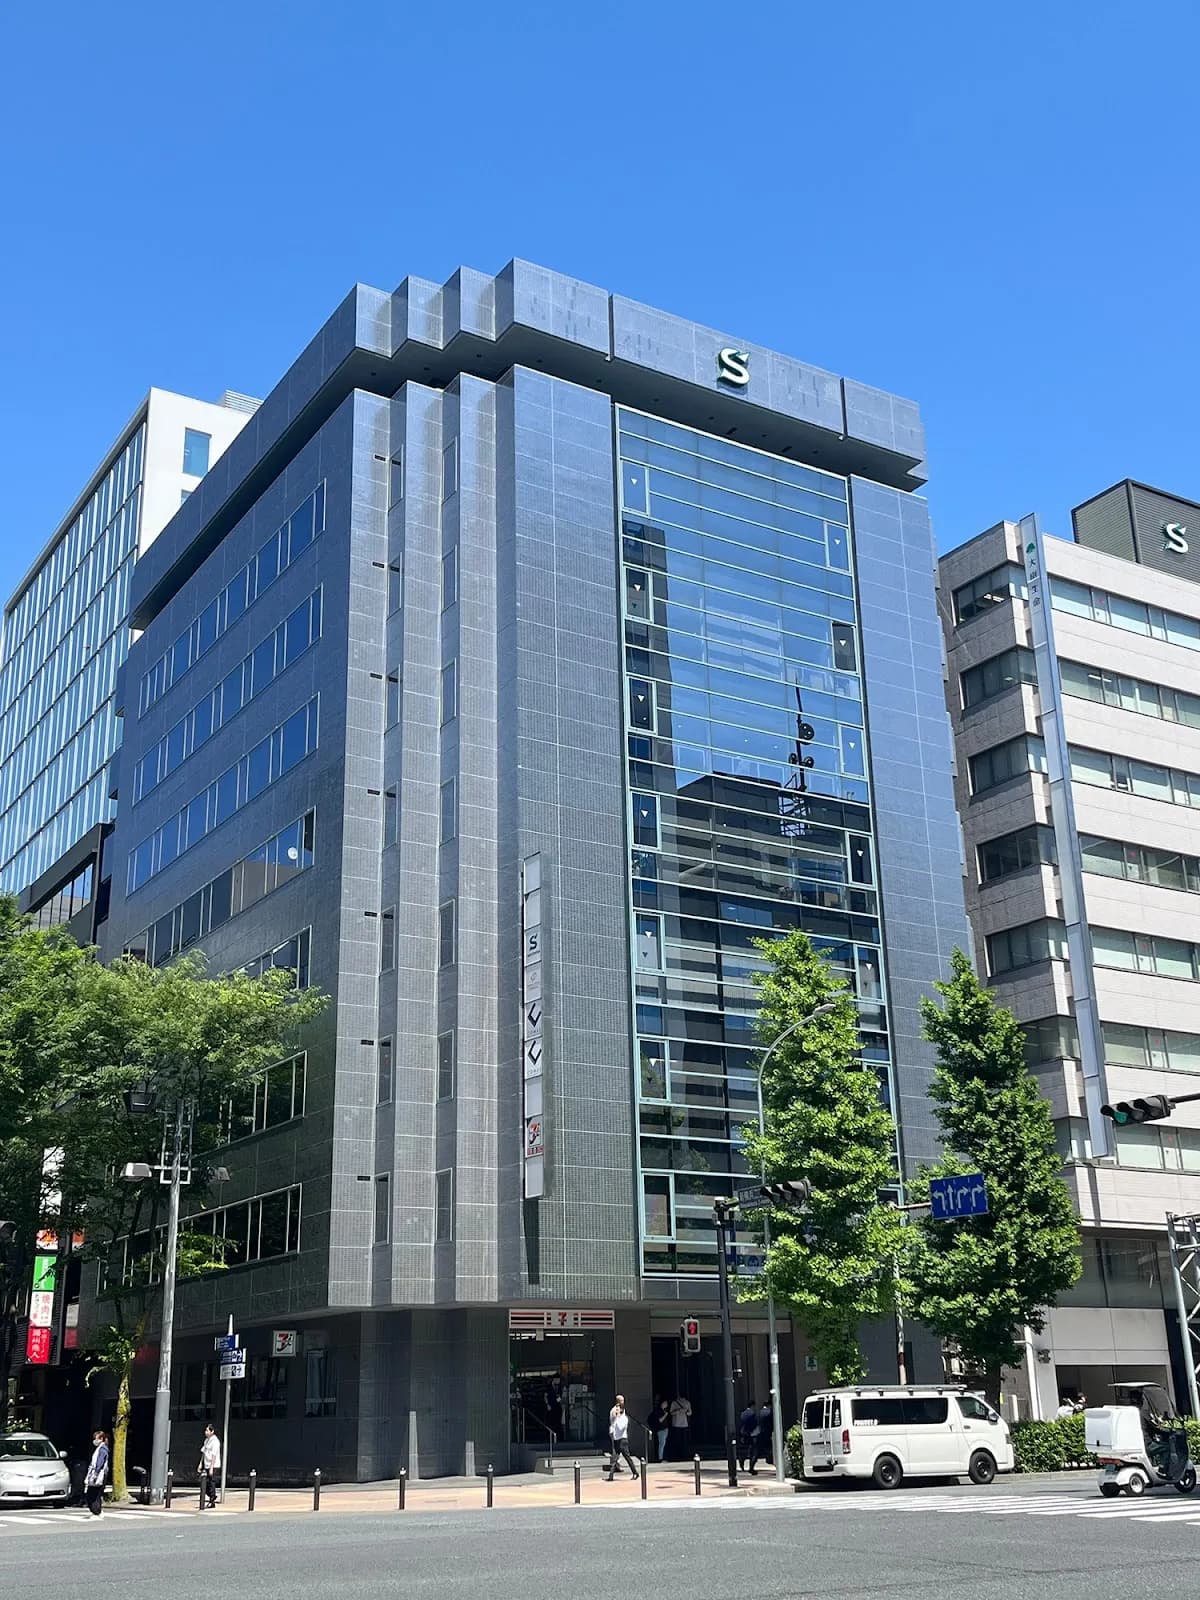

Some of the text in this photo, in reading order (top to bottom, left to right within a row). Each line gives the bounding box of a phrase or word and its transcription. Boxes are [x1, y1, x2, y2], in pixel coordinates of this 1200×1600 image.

[719, 347, 750, 386] S
[1163, 523, 1189, 555] S
[558, 1311, 567, 1326] 7
